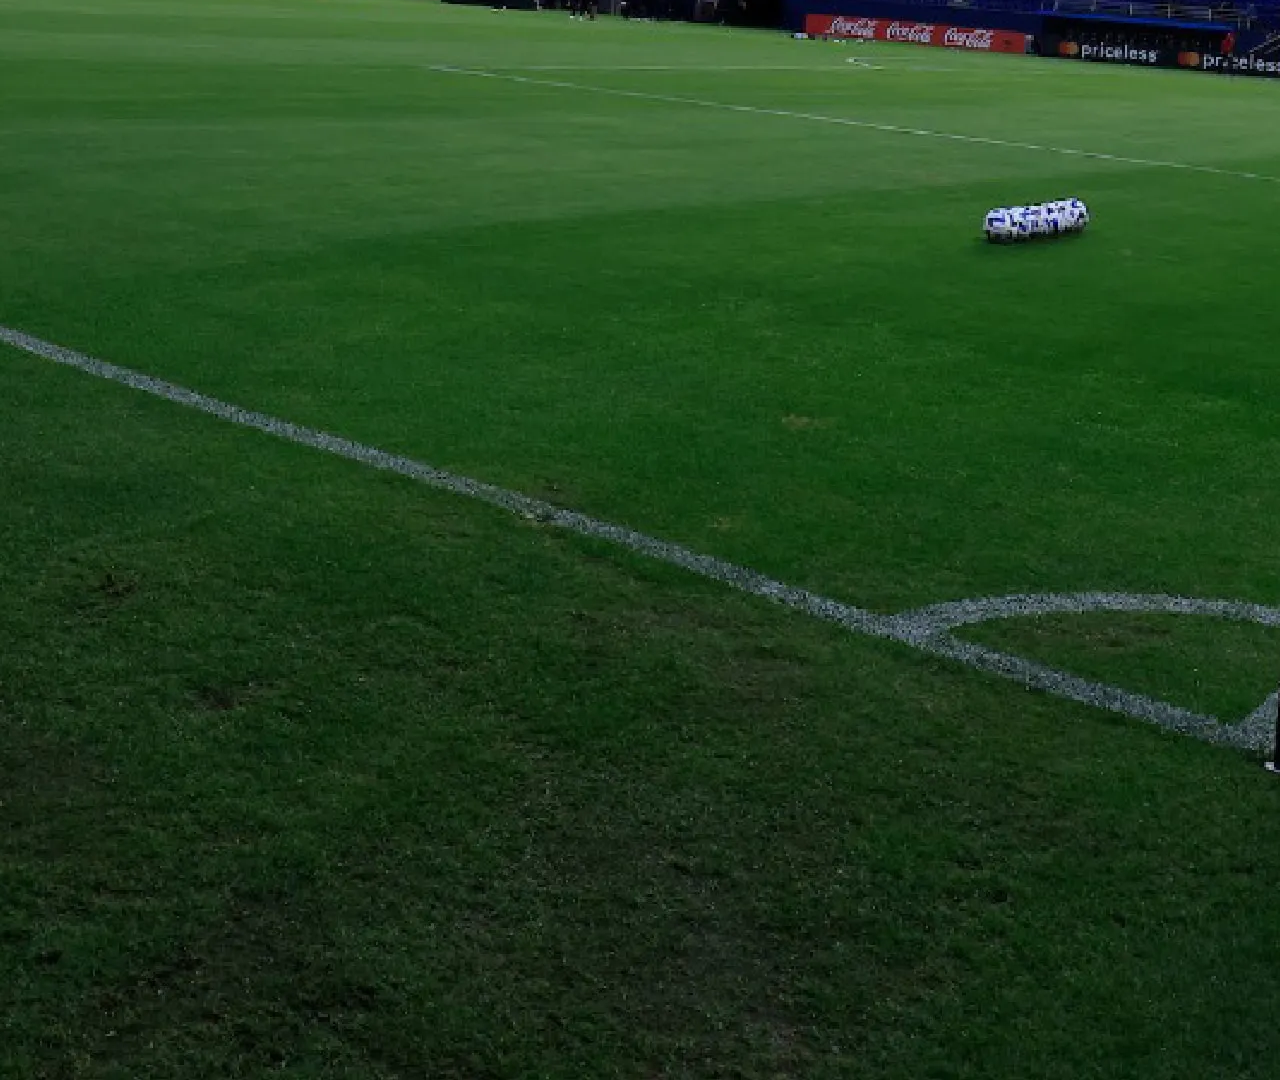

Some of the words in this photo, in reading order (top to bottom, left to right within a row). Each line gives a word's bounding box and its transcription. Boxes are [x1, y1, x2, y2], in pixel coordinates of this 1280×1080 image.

[831, 15, 876, 38] Coca-Cola
[887, 21, 934, 44] Coca-Cola
[944, 26, 993, 49] Coca-Cola
[1082, 41, 1157, 63] priceless
